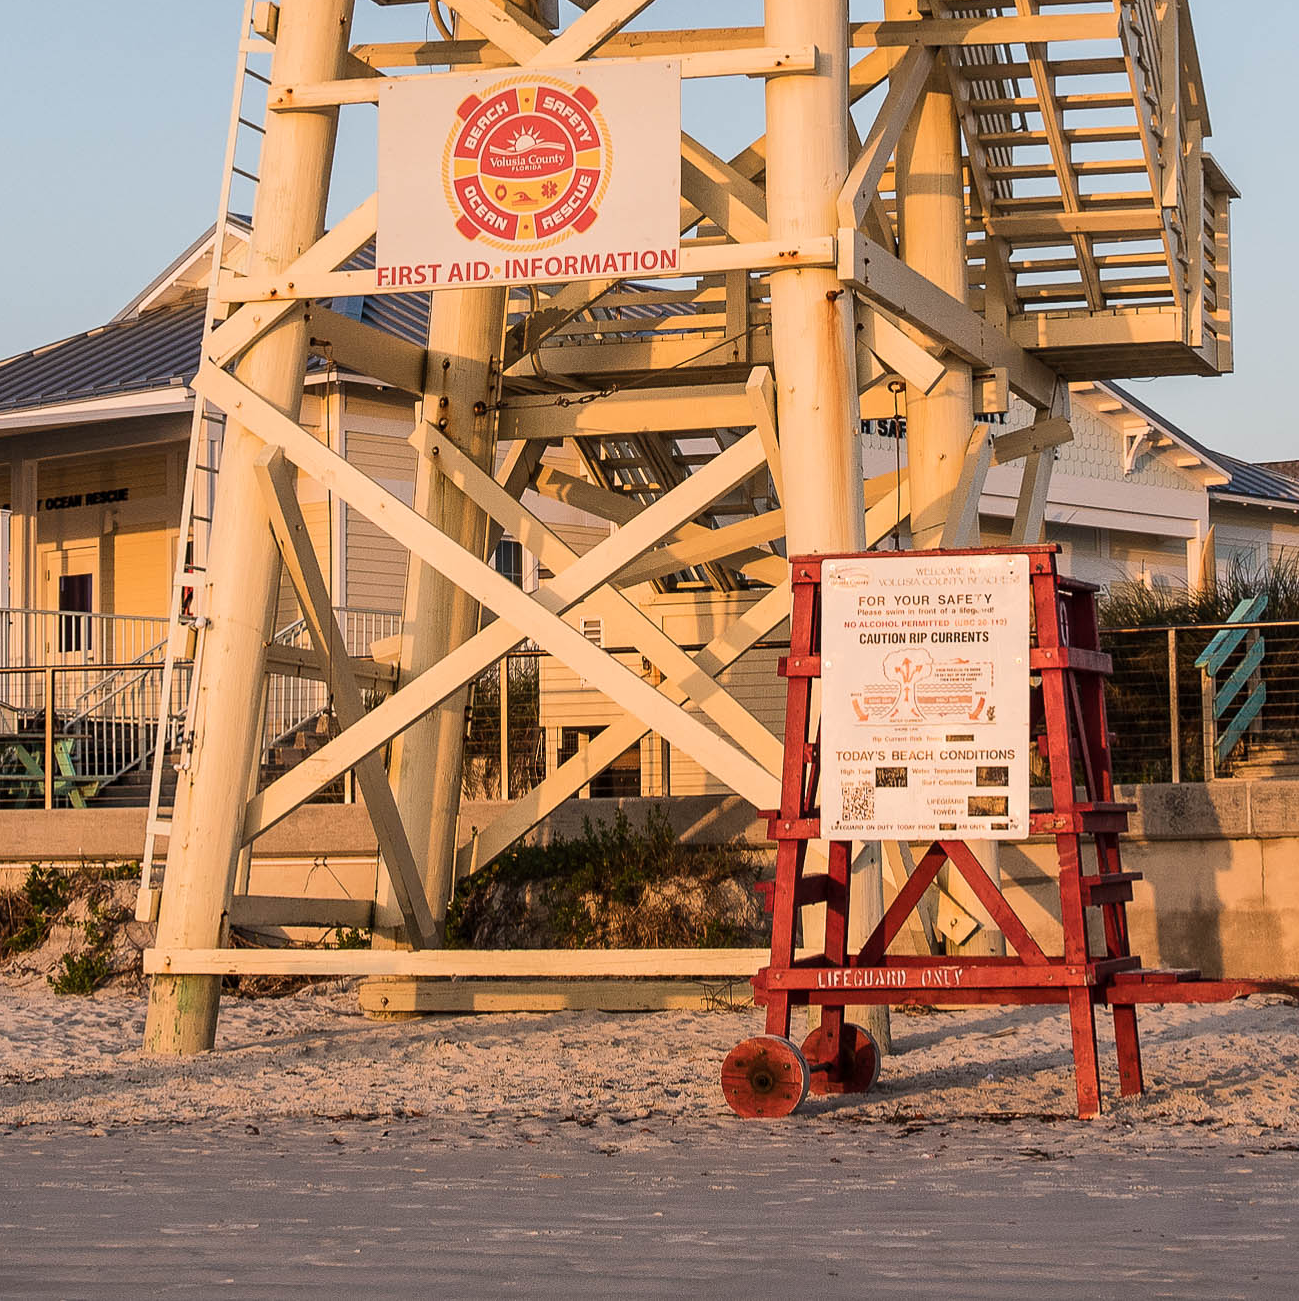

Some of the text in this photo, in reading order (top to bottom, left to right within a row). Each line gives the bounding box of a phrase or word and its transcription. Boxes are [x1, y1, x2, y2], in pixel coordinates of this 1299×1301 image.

[464, 96, 593, 150] BEACH SAFETY
[490, 154, 565, 168] Volusia County
[464, 175, 592, 231] OCEAN RESCUE
[377, 249, 677, 286] FIRST AID INFORMATION
[45, 494, 82, 511] OCEAN
[86, 488, 129, 506] RESCUE
[858, 596, 885, 607] FOR
[894, 595, 930, 606] YOUR
[940, 607, 948, 615] of
[844, 621, 857, 629] NO
[859, 620, 899, 629] ALCOHOL
[901, 619, 950, 628] PERMITTED
[859, 631, 989, 645] CAUTION RIP CURRENTS
[836, 749, 1016, 761] TODAY'S BEACH CONDITIONS
[817, 968, 964, 988] LIFEGUARD ONLY
